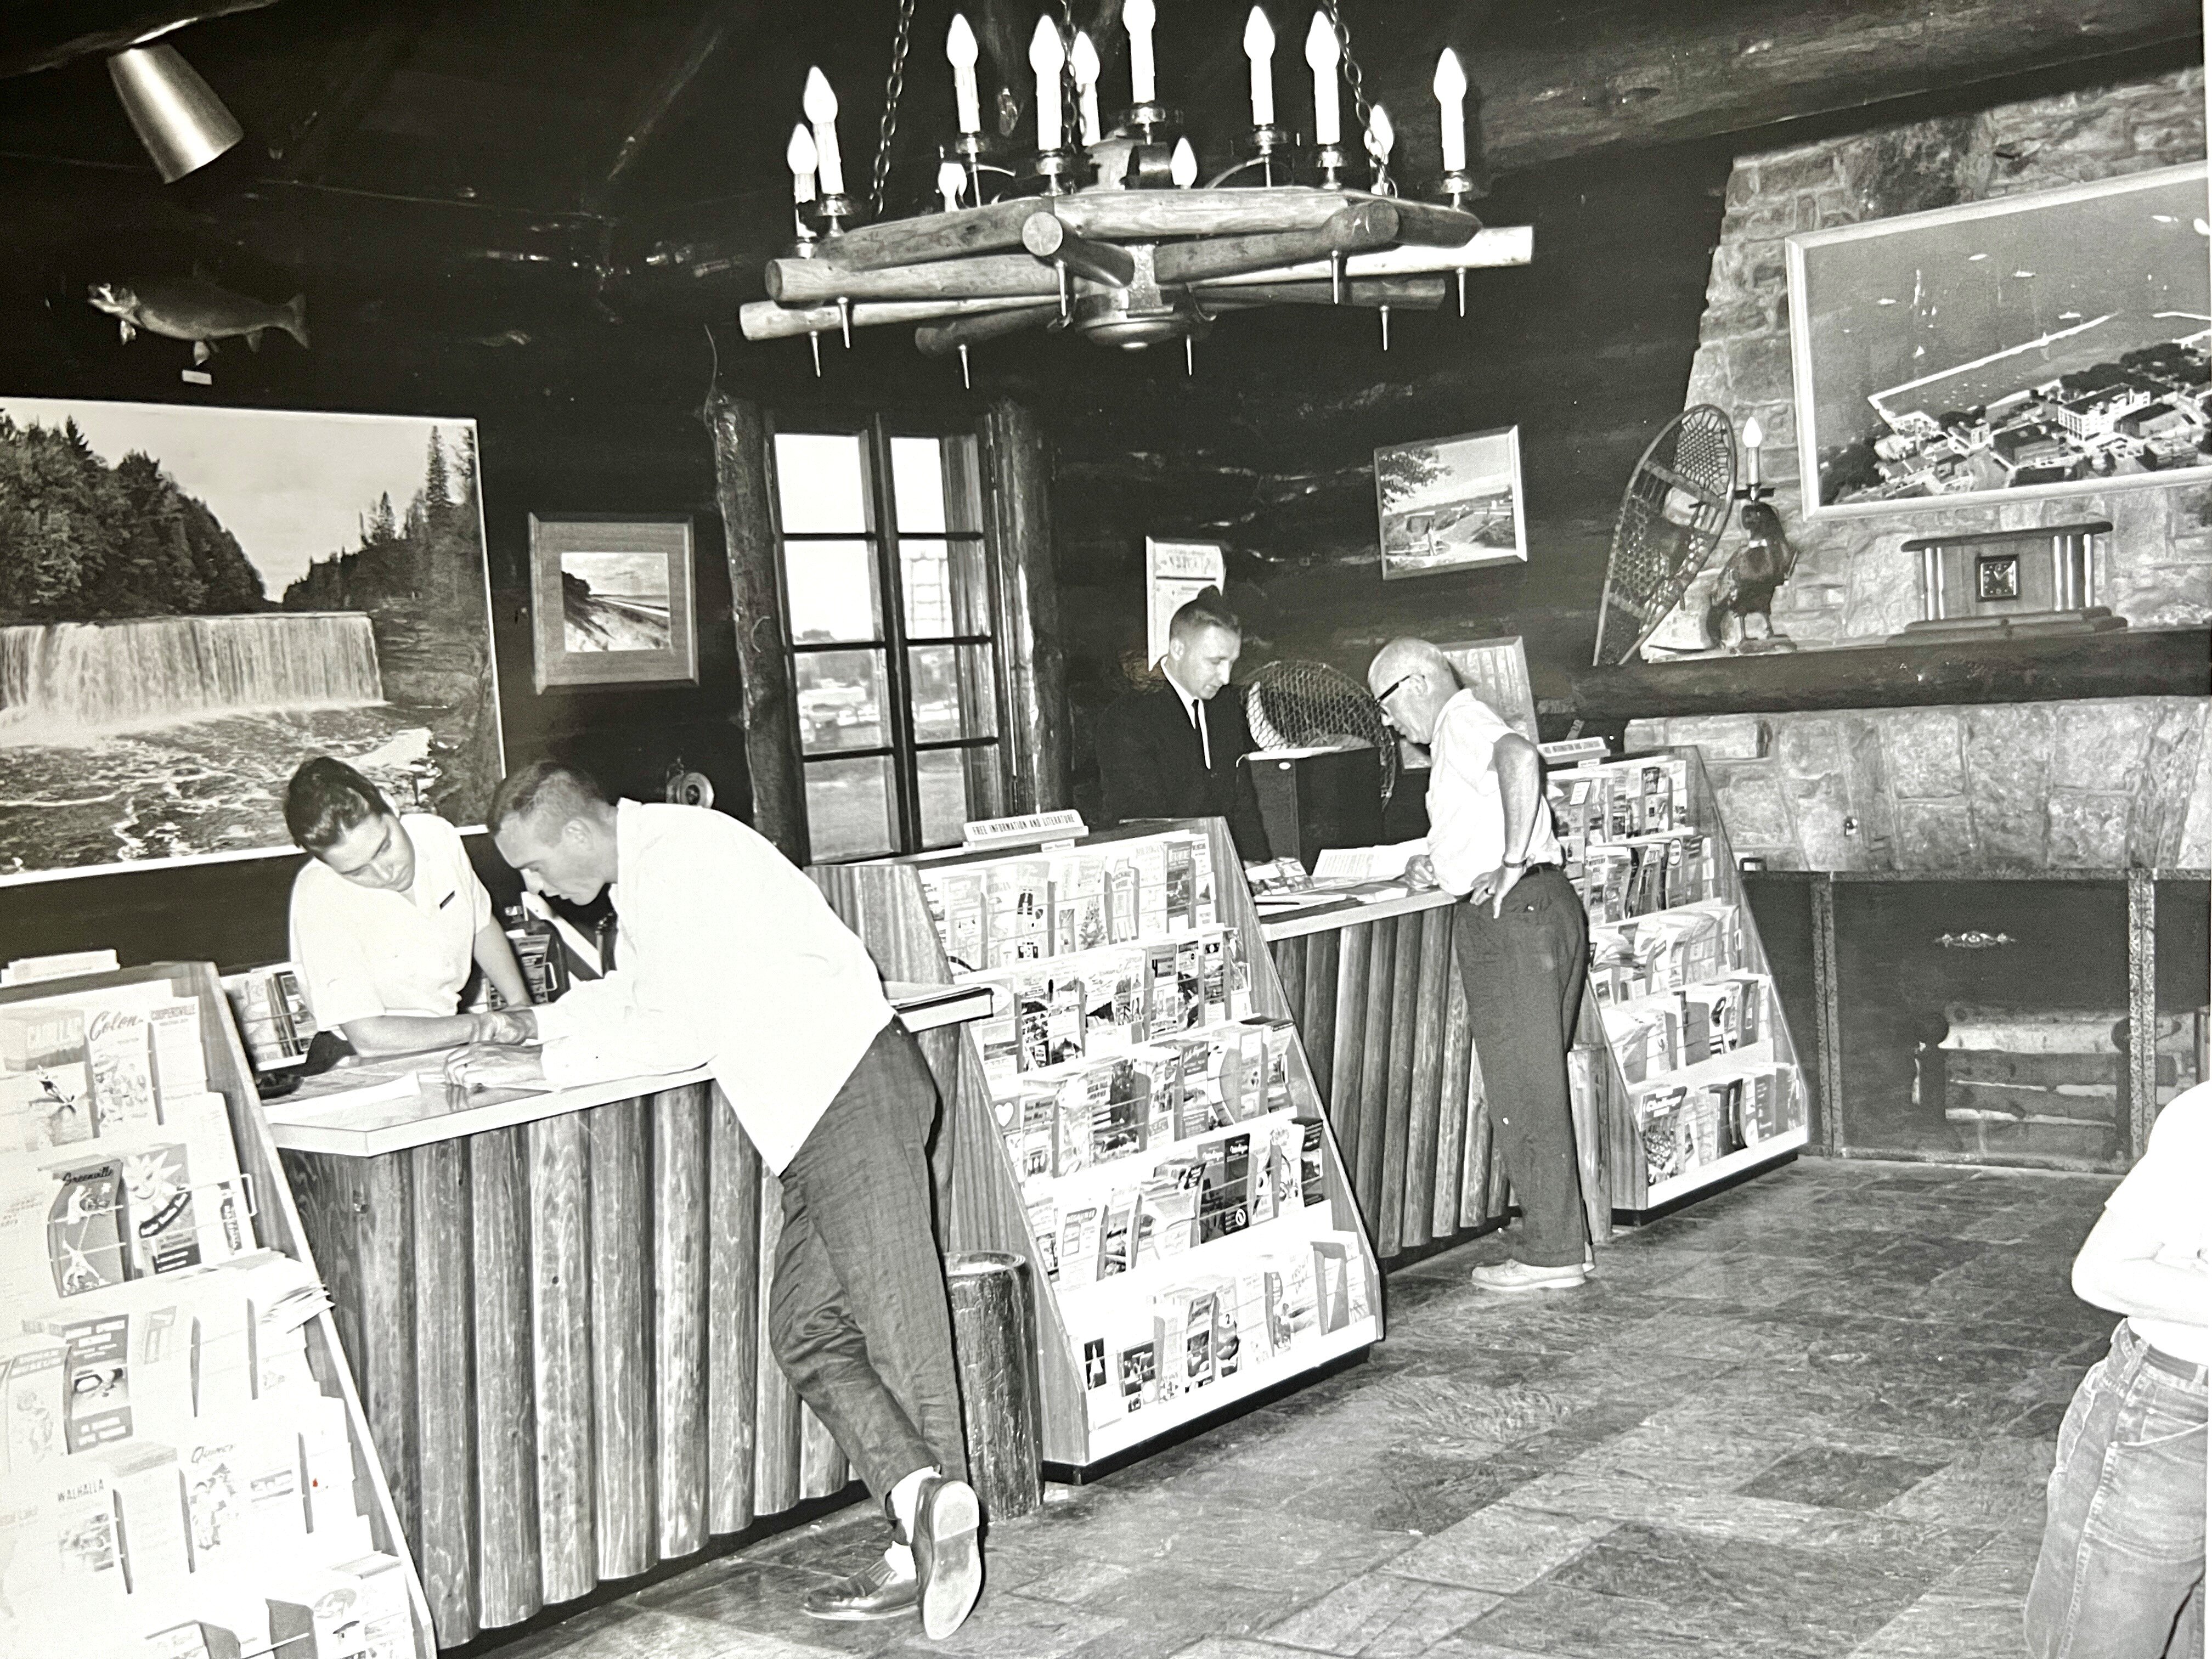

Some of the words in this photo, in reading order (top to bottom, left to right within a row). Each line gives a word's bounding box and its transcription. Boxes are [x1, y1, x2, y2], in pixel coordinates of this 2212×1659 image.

[972, 826, 988, 835] FREE
[989, 820, 1028, 833] INFORMATION
[1029, 818, 1041, 828] AND
[1042, 814, 1075, 827] LITERATURE
[89, 1010, 143, 1041] Colon
[63, 1166, 114, 1186] Greenville
[58, 1479, 104, 1502] WALHALLA
